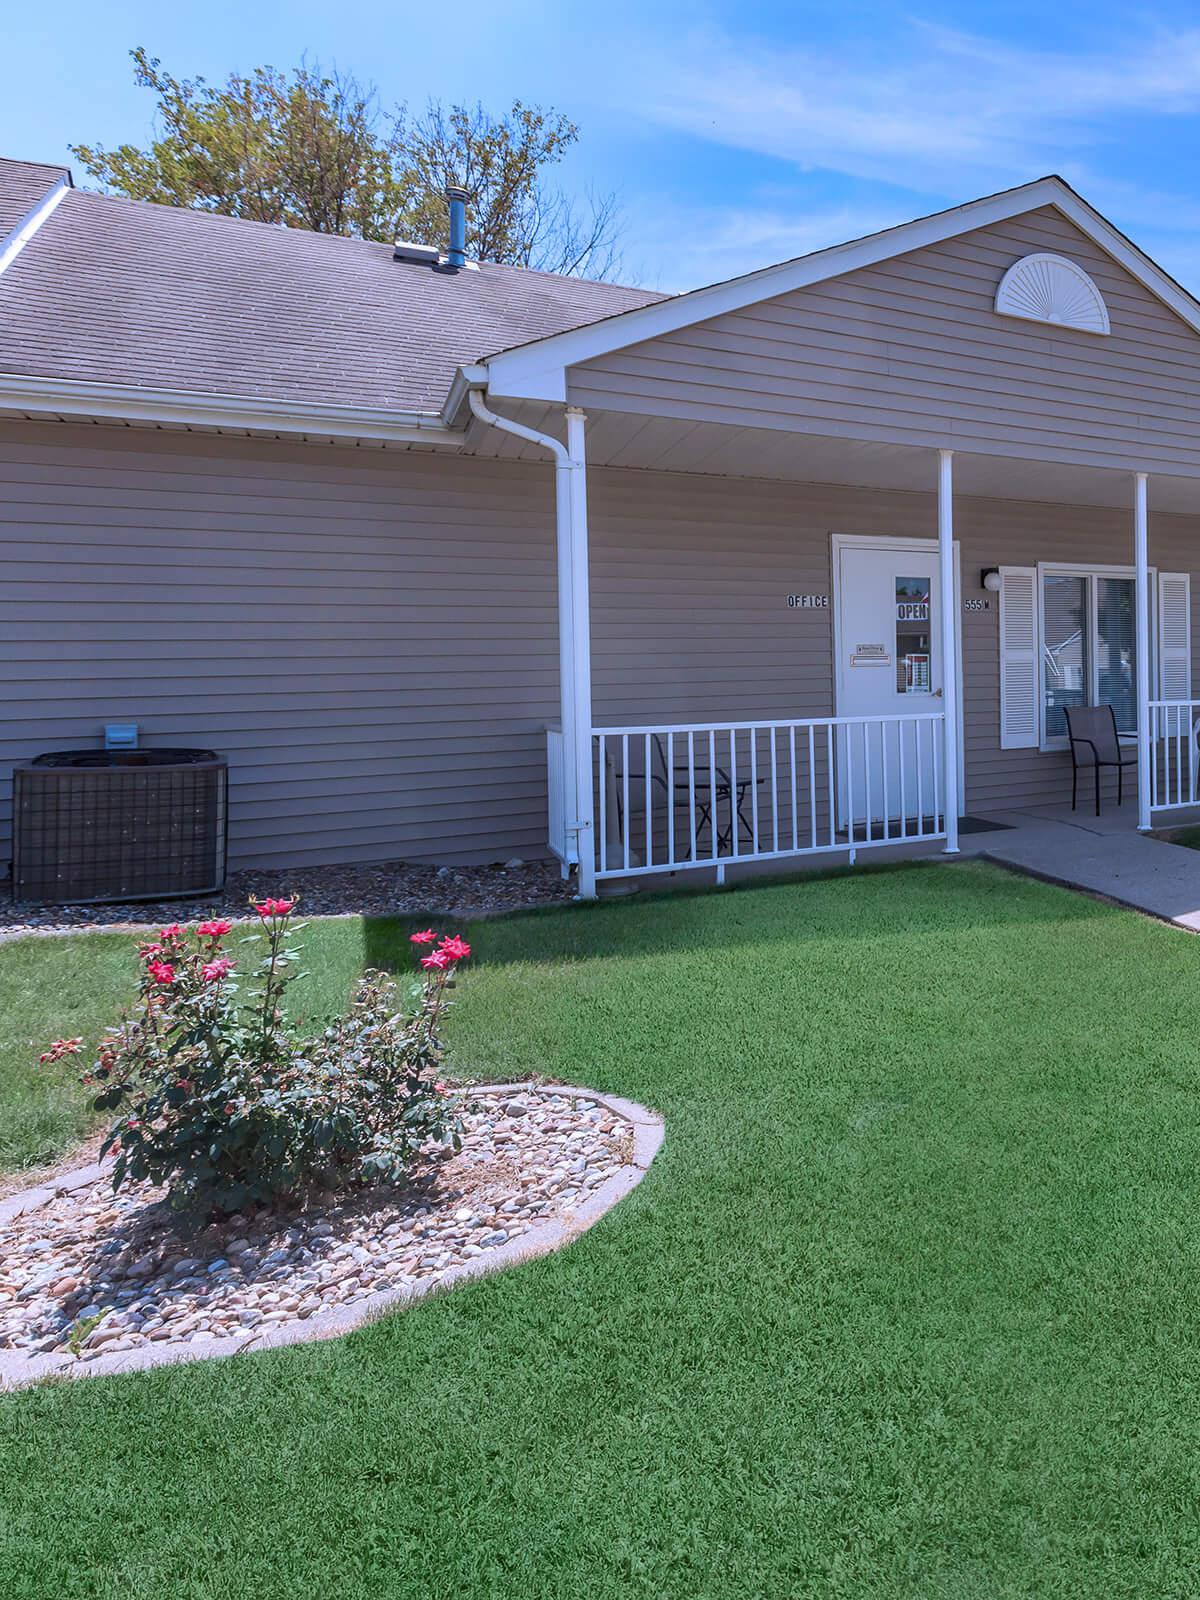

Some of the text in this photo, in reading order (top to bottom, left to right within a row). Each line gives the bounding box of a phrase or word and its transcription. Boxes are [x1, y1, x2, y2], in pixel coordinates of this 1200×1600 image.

[788, 595, 827, 608] OFFICE
[965, 599, 981, 610] 555
[898, 604, 927, 619] OPEN
